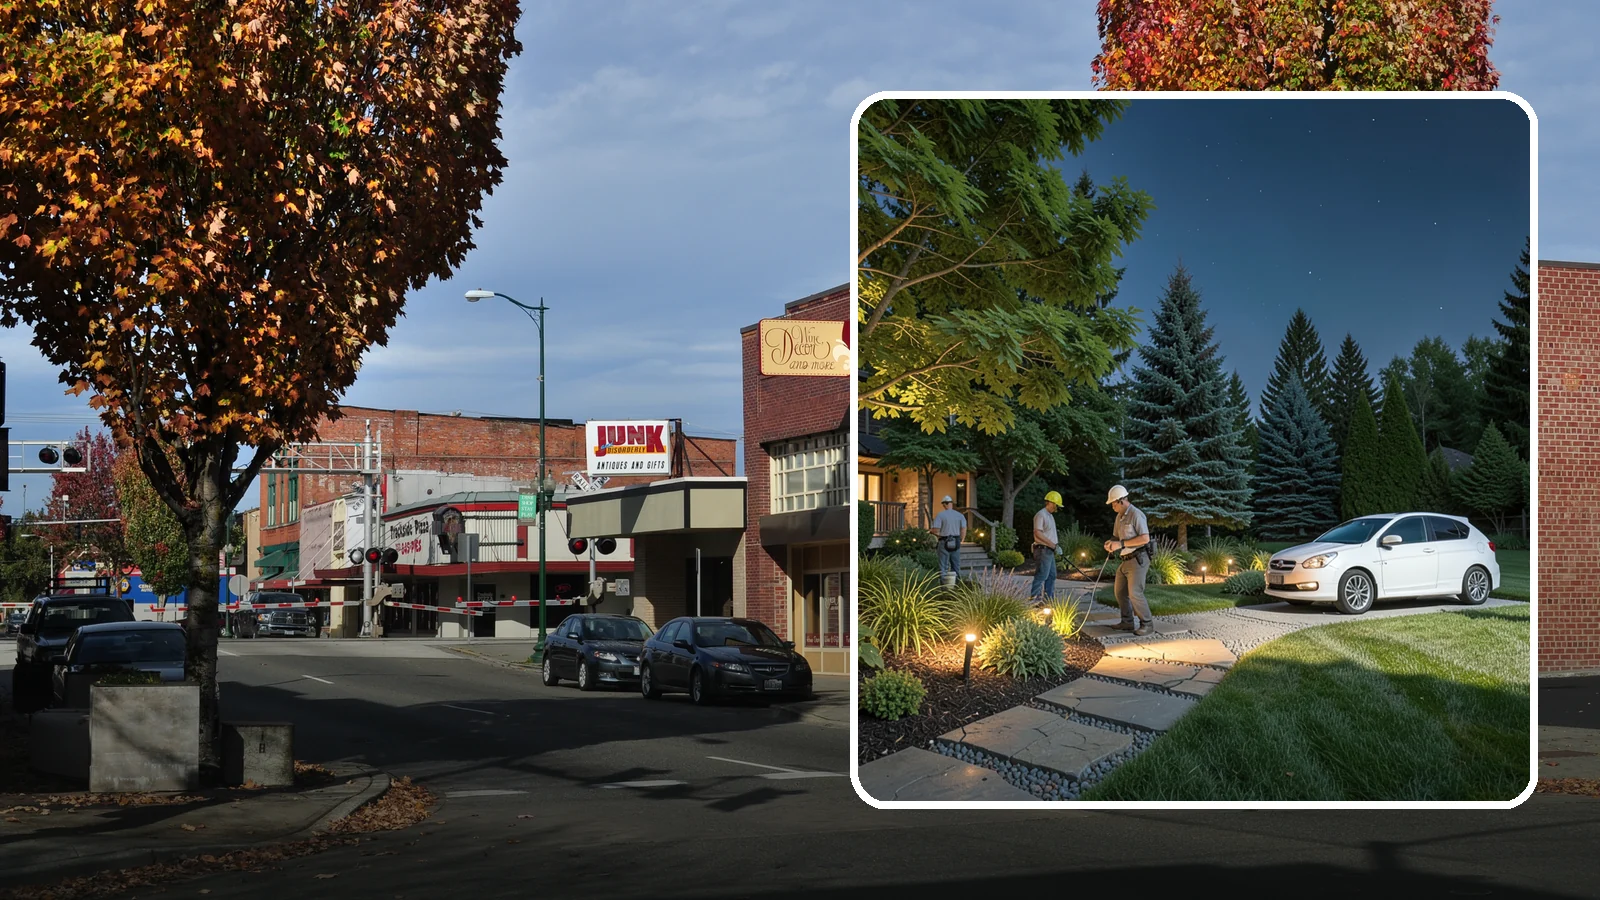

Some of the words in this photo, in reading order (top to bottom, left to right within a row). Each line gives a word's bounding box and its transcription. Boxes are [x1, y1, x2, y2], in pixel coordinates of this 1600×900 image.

[596, 425, 665, 457] JUNK
[597, 461, 628, 470] ANTIQUES
[631, 461, 644, 470] AND
[647, 460, 665, 470] GIFTS
[390, 522, 413, 539] Trackside
[414, 519, 429, 535] Pizza
